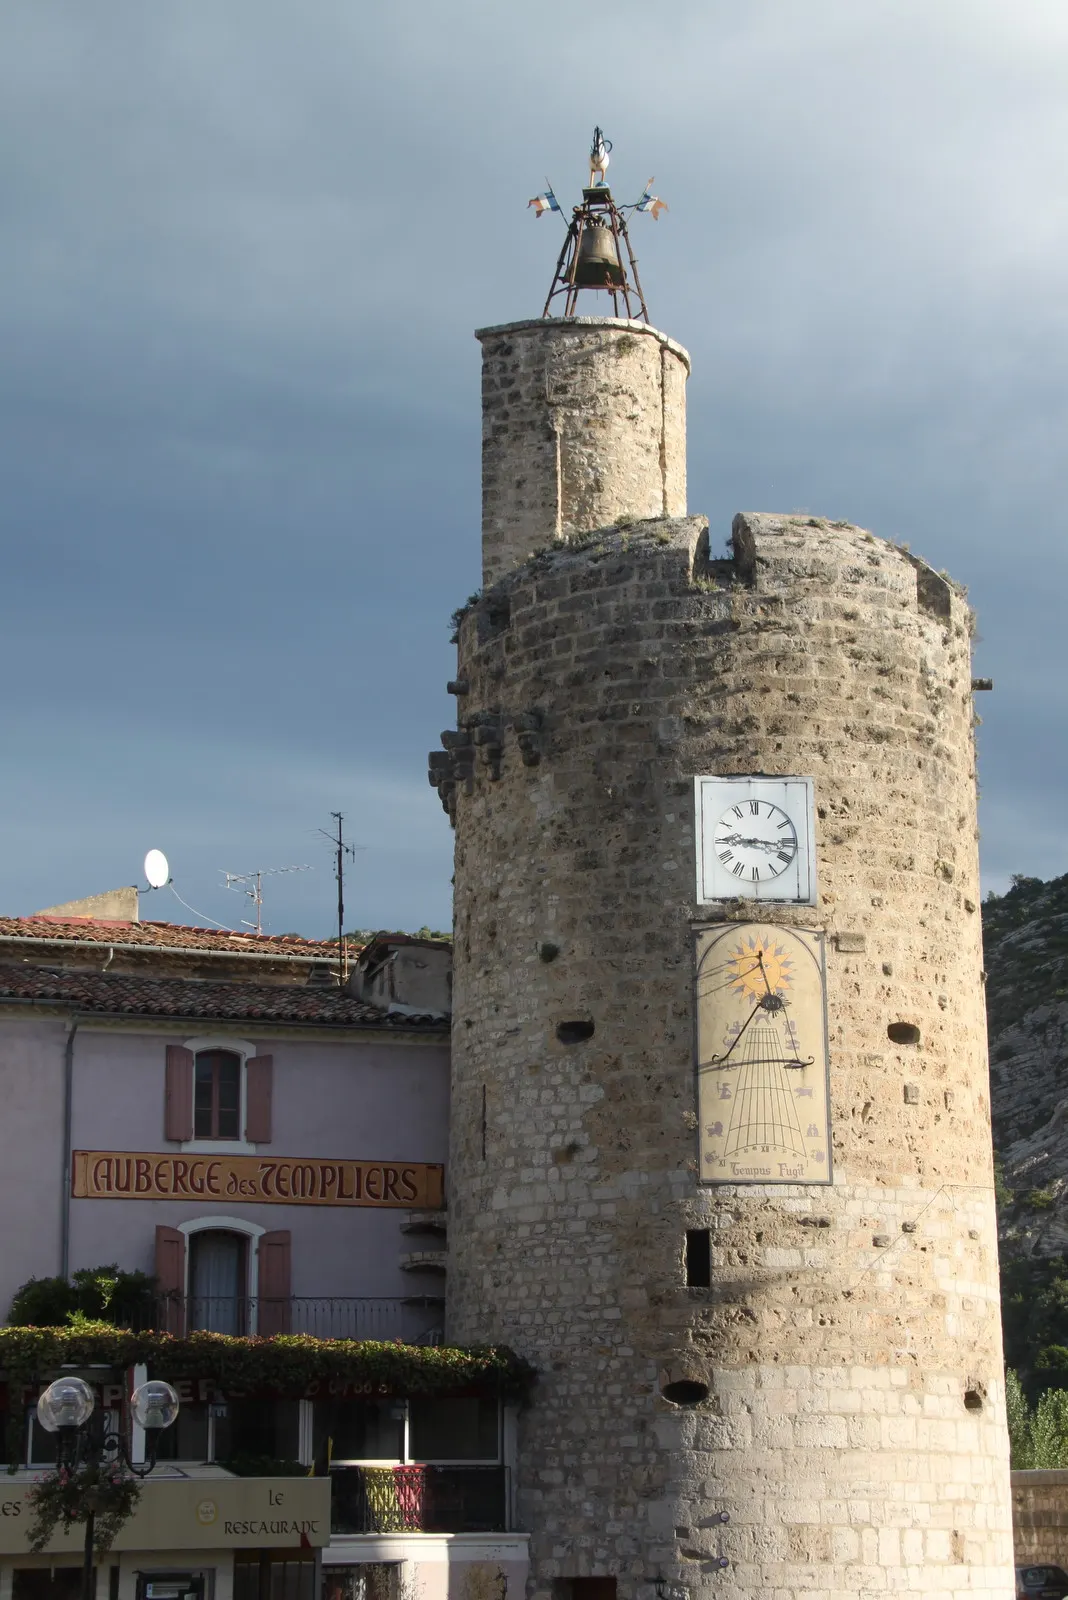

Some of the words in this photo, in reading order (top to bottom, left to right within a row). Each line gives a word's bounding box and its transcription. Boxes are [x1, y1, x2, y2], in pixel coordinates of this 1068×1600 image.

[749, 801, 759, 815] XII
[729, 1161, 772, 1178] Tempus
[777, 1162, 805, 1179] Fugit
[92, 1157, 222, 1196] AUBERGE
[257, 1163, 418, 1202] TEMPLIERS
